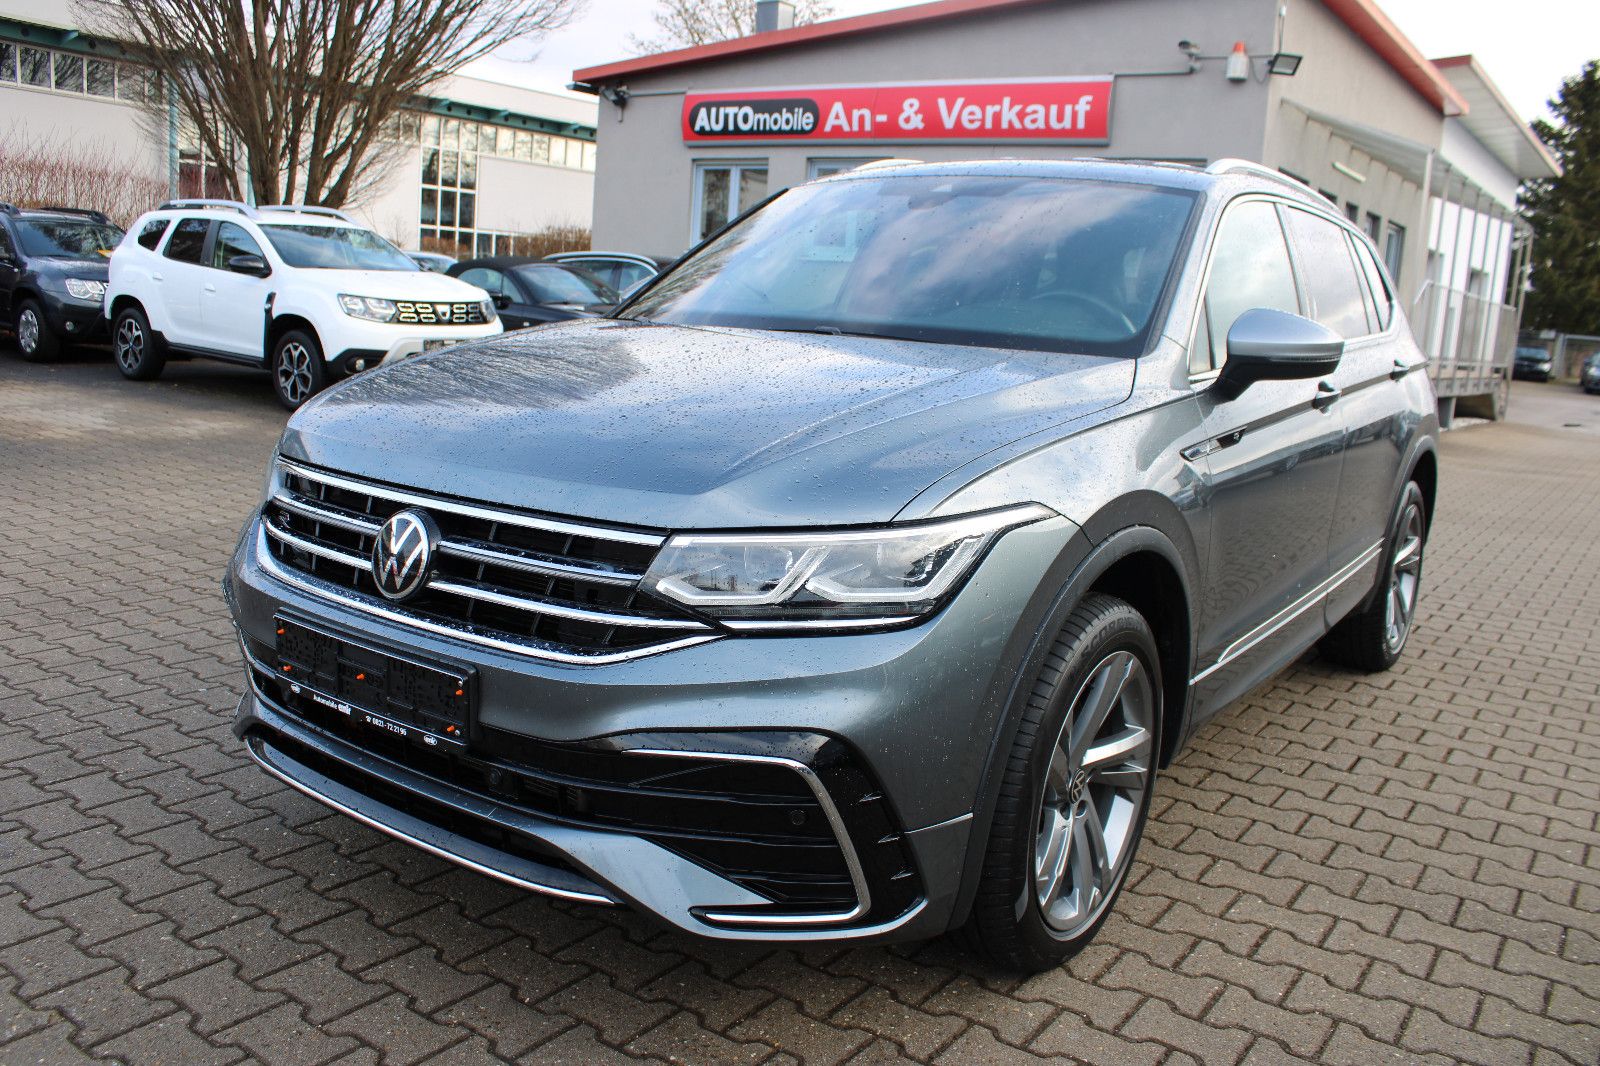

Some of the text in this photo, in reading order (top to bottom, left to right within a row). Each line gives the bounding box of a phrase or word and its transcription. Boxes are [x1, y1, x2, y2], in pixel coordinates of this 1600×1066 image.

[694, 95, 1094, 132] AUTOmobile An- & Verkauf
